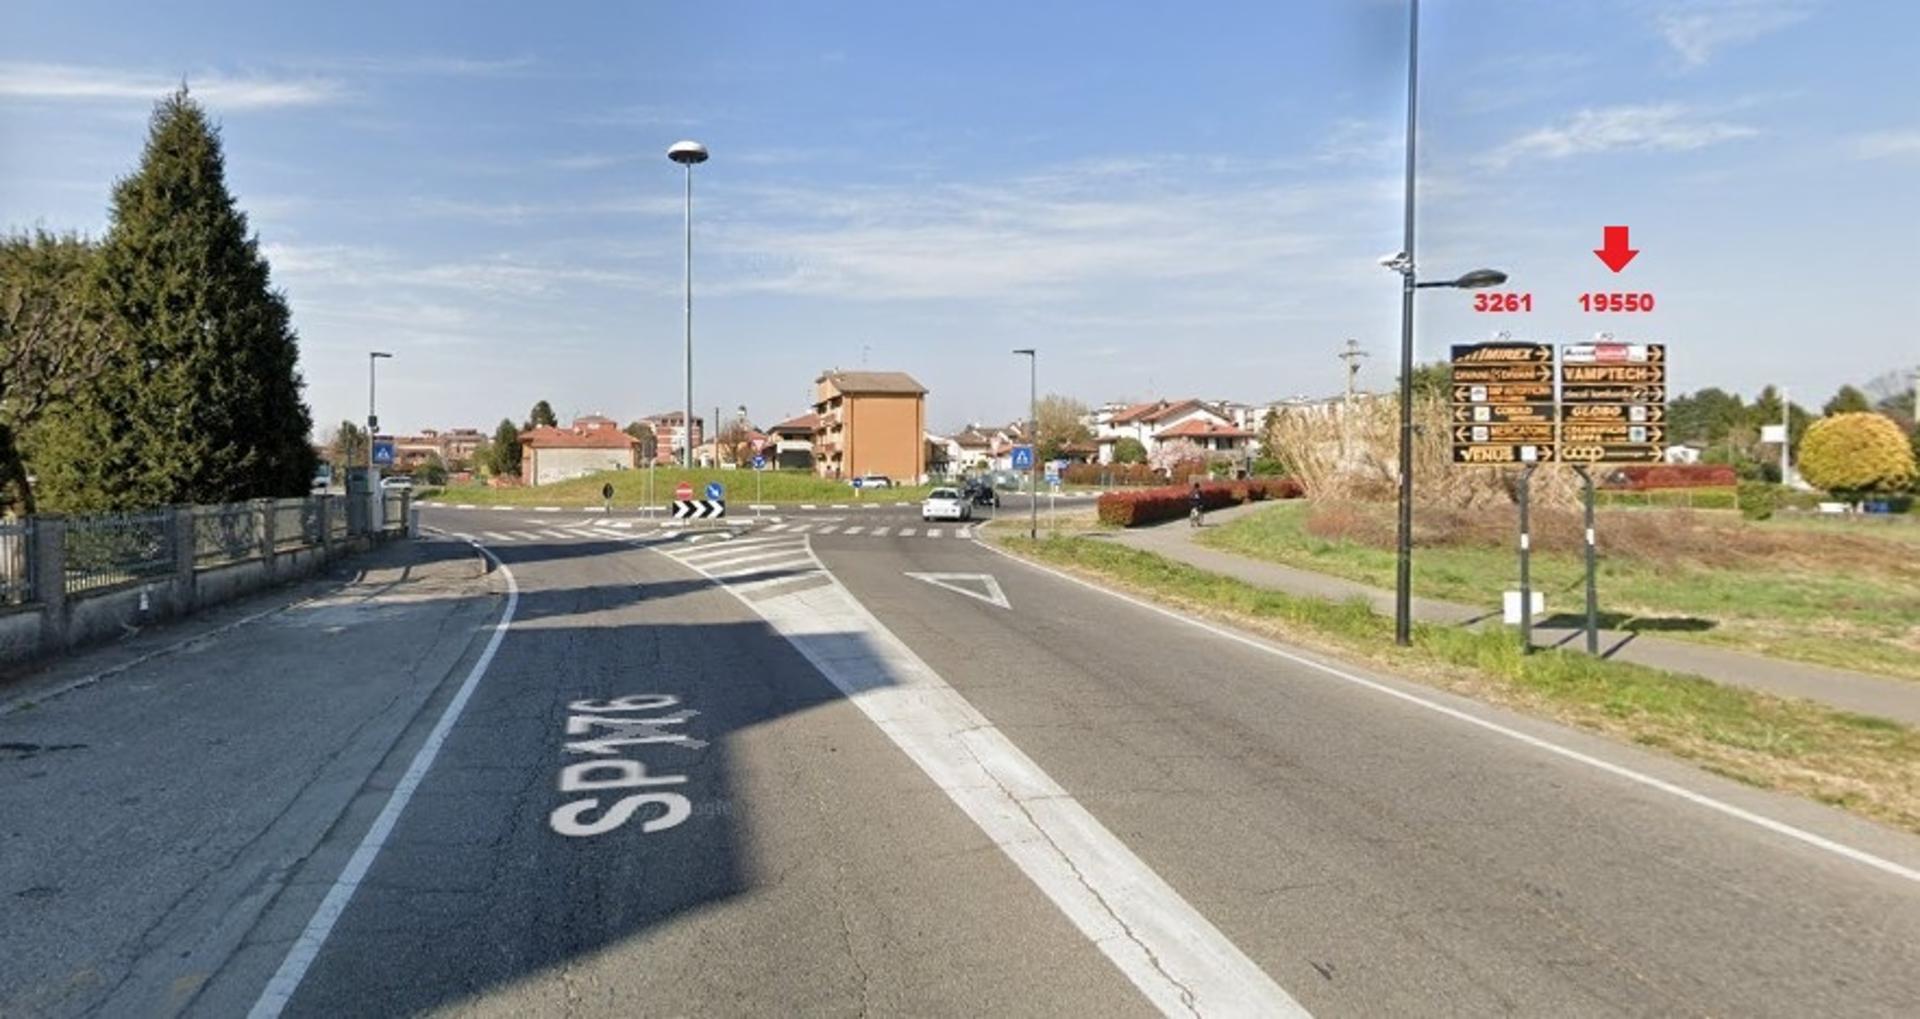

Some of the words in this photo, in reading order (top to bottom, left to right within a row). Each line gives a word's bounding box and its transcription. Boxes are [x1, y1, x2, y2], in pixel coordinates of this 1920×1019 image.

[1564, 367, 1648, 380] VAMPTECH
[1460, 445, 1515, 461] VENUS
[549, 694, 702, 837] SP176
